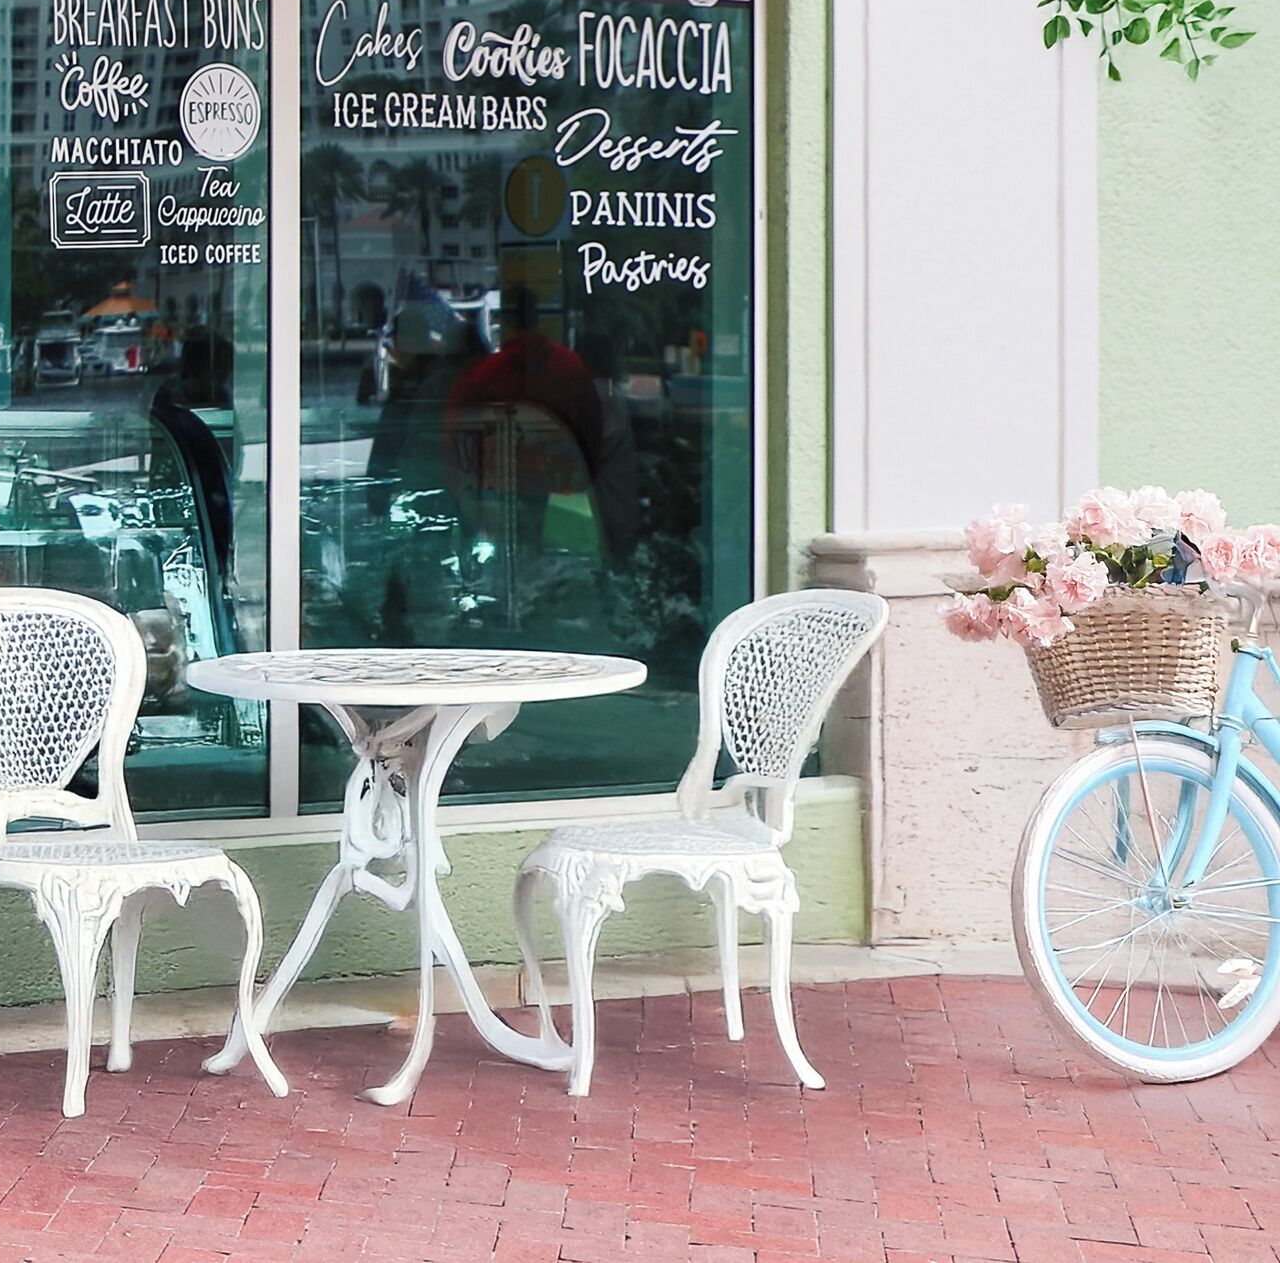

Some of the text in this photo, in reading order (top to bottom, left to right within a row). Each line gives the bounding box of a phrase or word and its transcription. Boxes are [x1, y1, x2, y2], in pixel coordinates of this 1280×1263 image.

[316, 0, 732, 94] Cakes Cookies FOCACCIA
[61, 55, 148, 122] Coffee
[189, 101, 254, 124] ESPRESSO
[334, 92, 547, 131] ICE CREAM BARS
[51, 137, 183, 166] MACCHIATO
[555, 108, 738, 173] Desserts
[197, 166, 240, 197] Tea
[66, 186, 134, 233] Latte
[158, 195, 265, 232] Cappuccino
[570, 191, 716, 228] PANINIS
[160, 244, 261, 264] ICED COFFEE
[578, 242, 711, 294] Pastries
